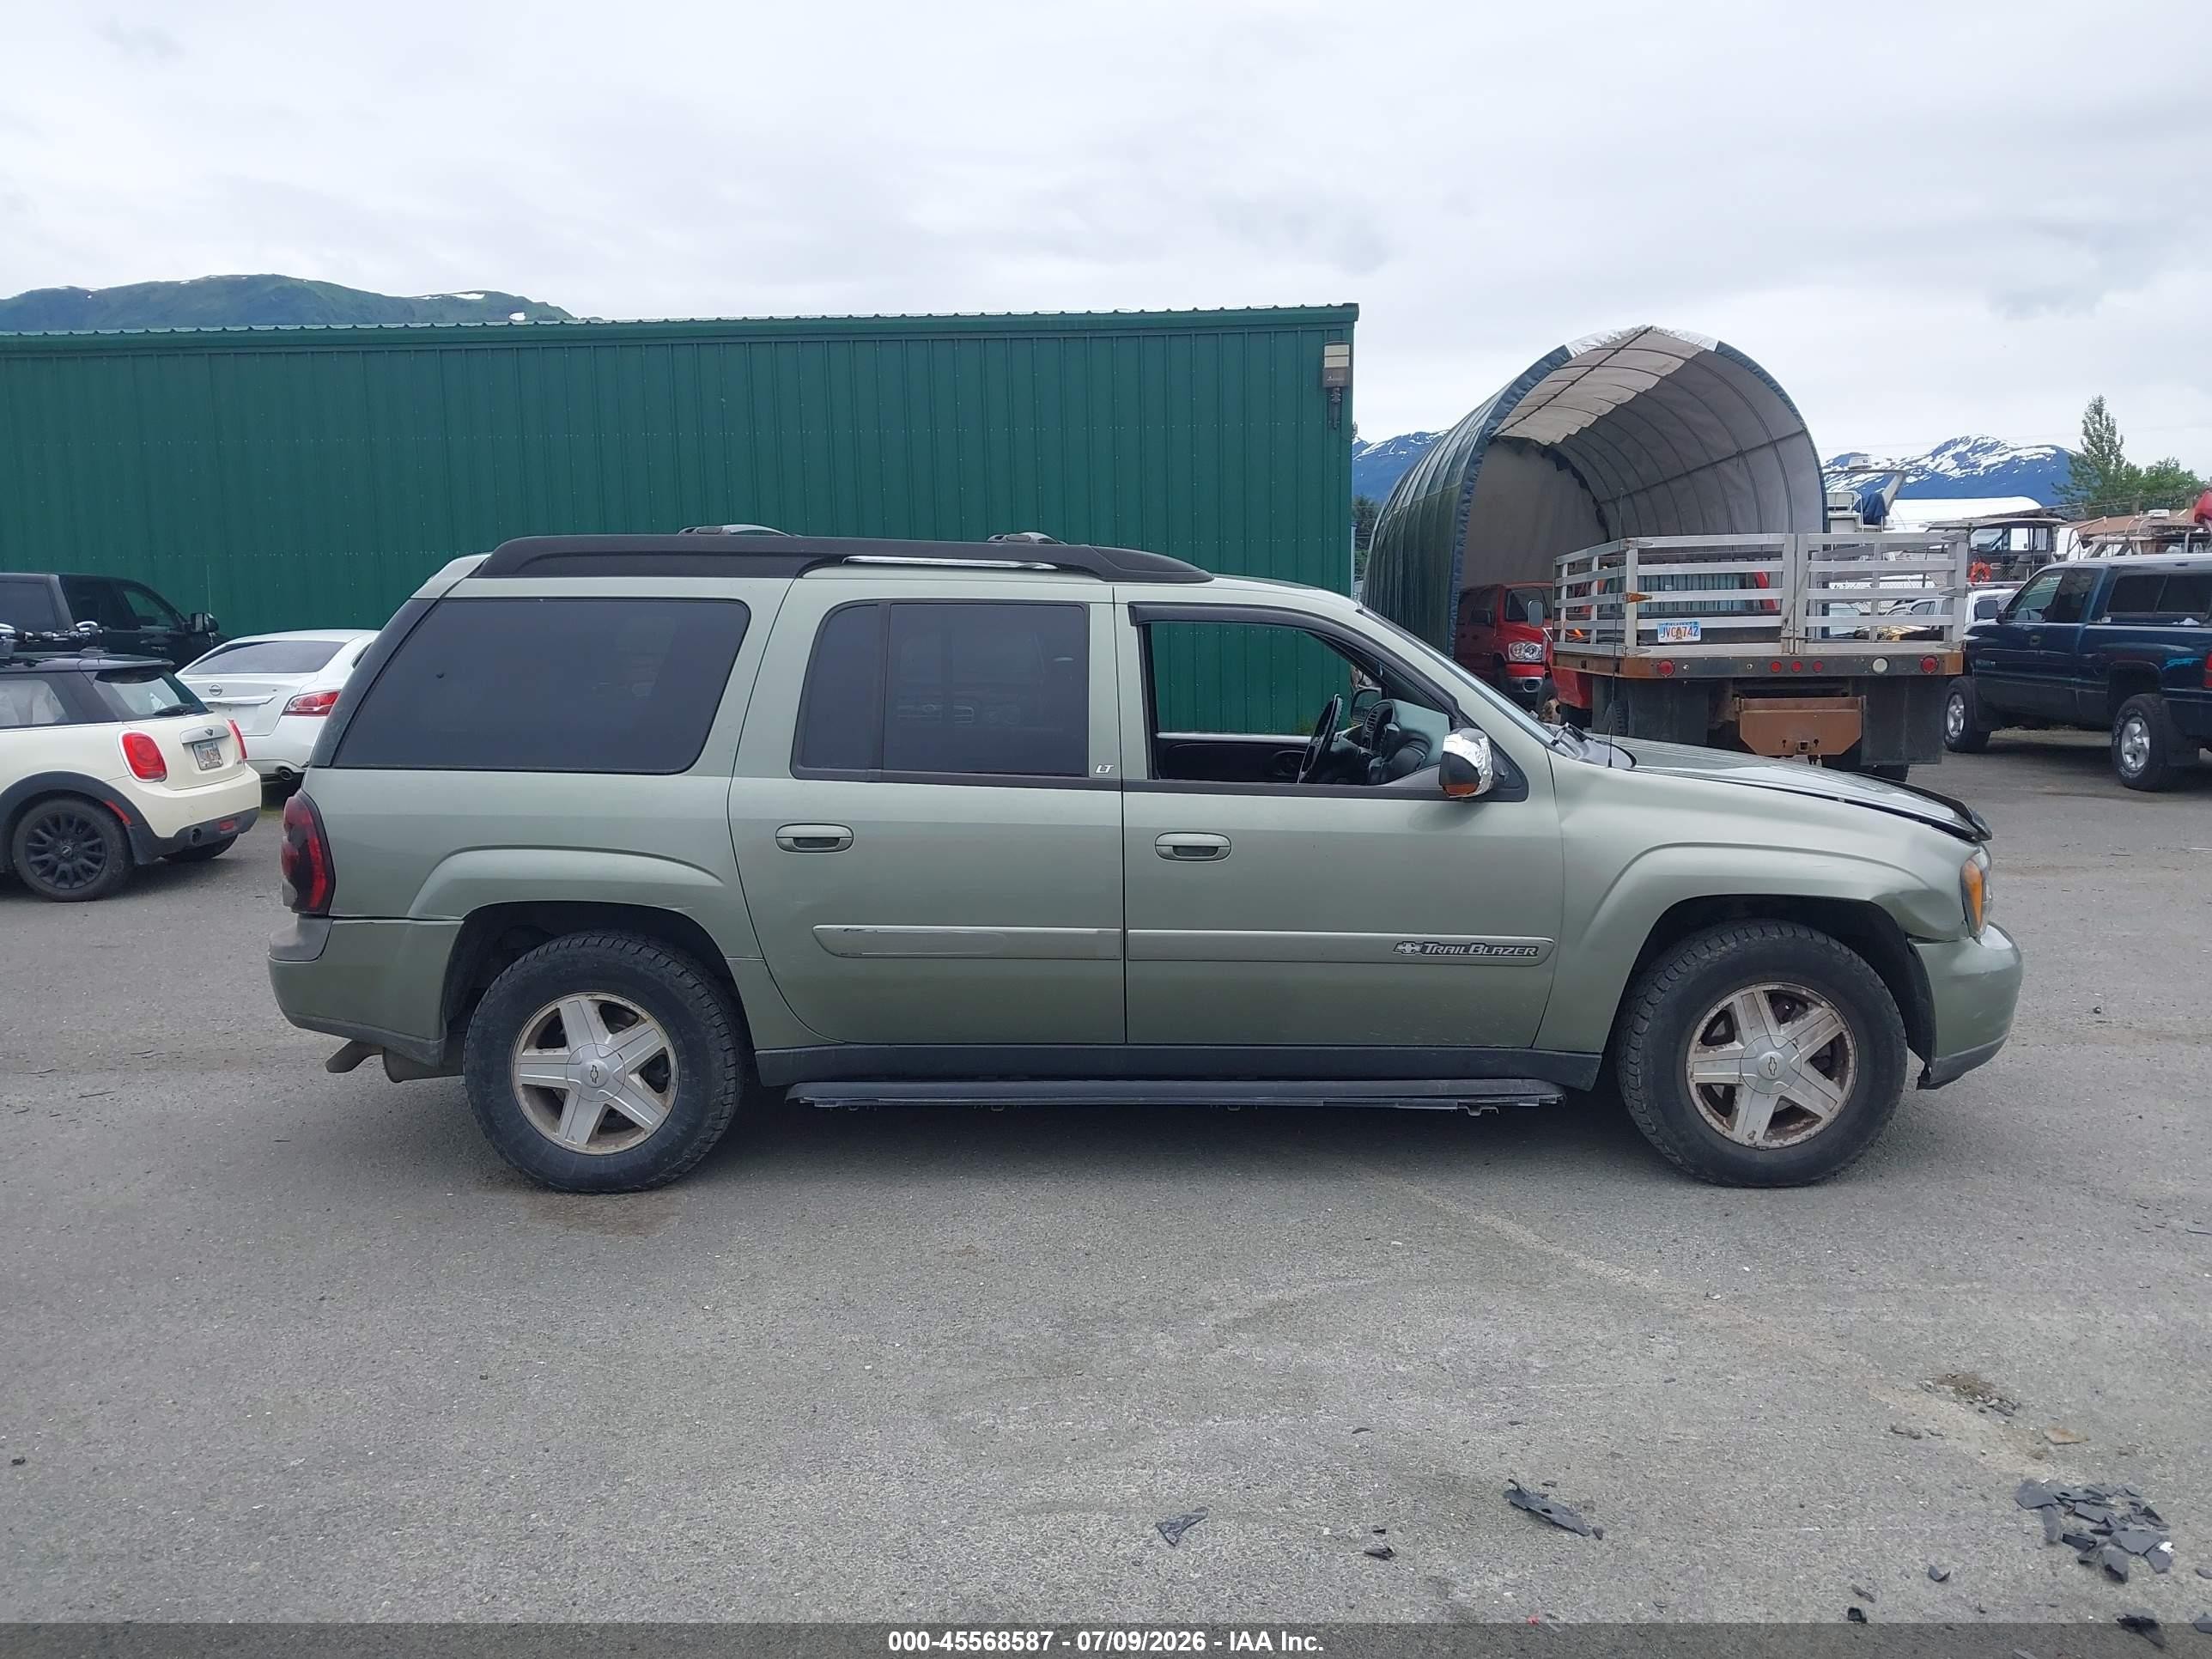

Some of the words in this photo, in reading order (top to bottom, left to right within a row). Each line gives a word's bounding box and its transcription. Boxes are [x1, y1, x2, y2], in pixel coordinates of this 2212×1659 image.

[1661, 626, 1676, 638] JVC
[1682, 625, 1698, 637] 742
[1095, 764, 1115, 774] LT
